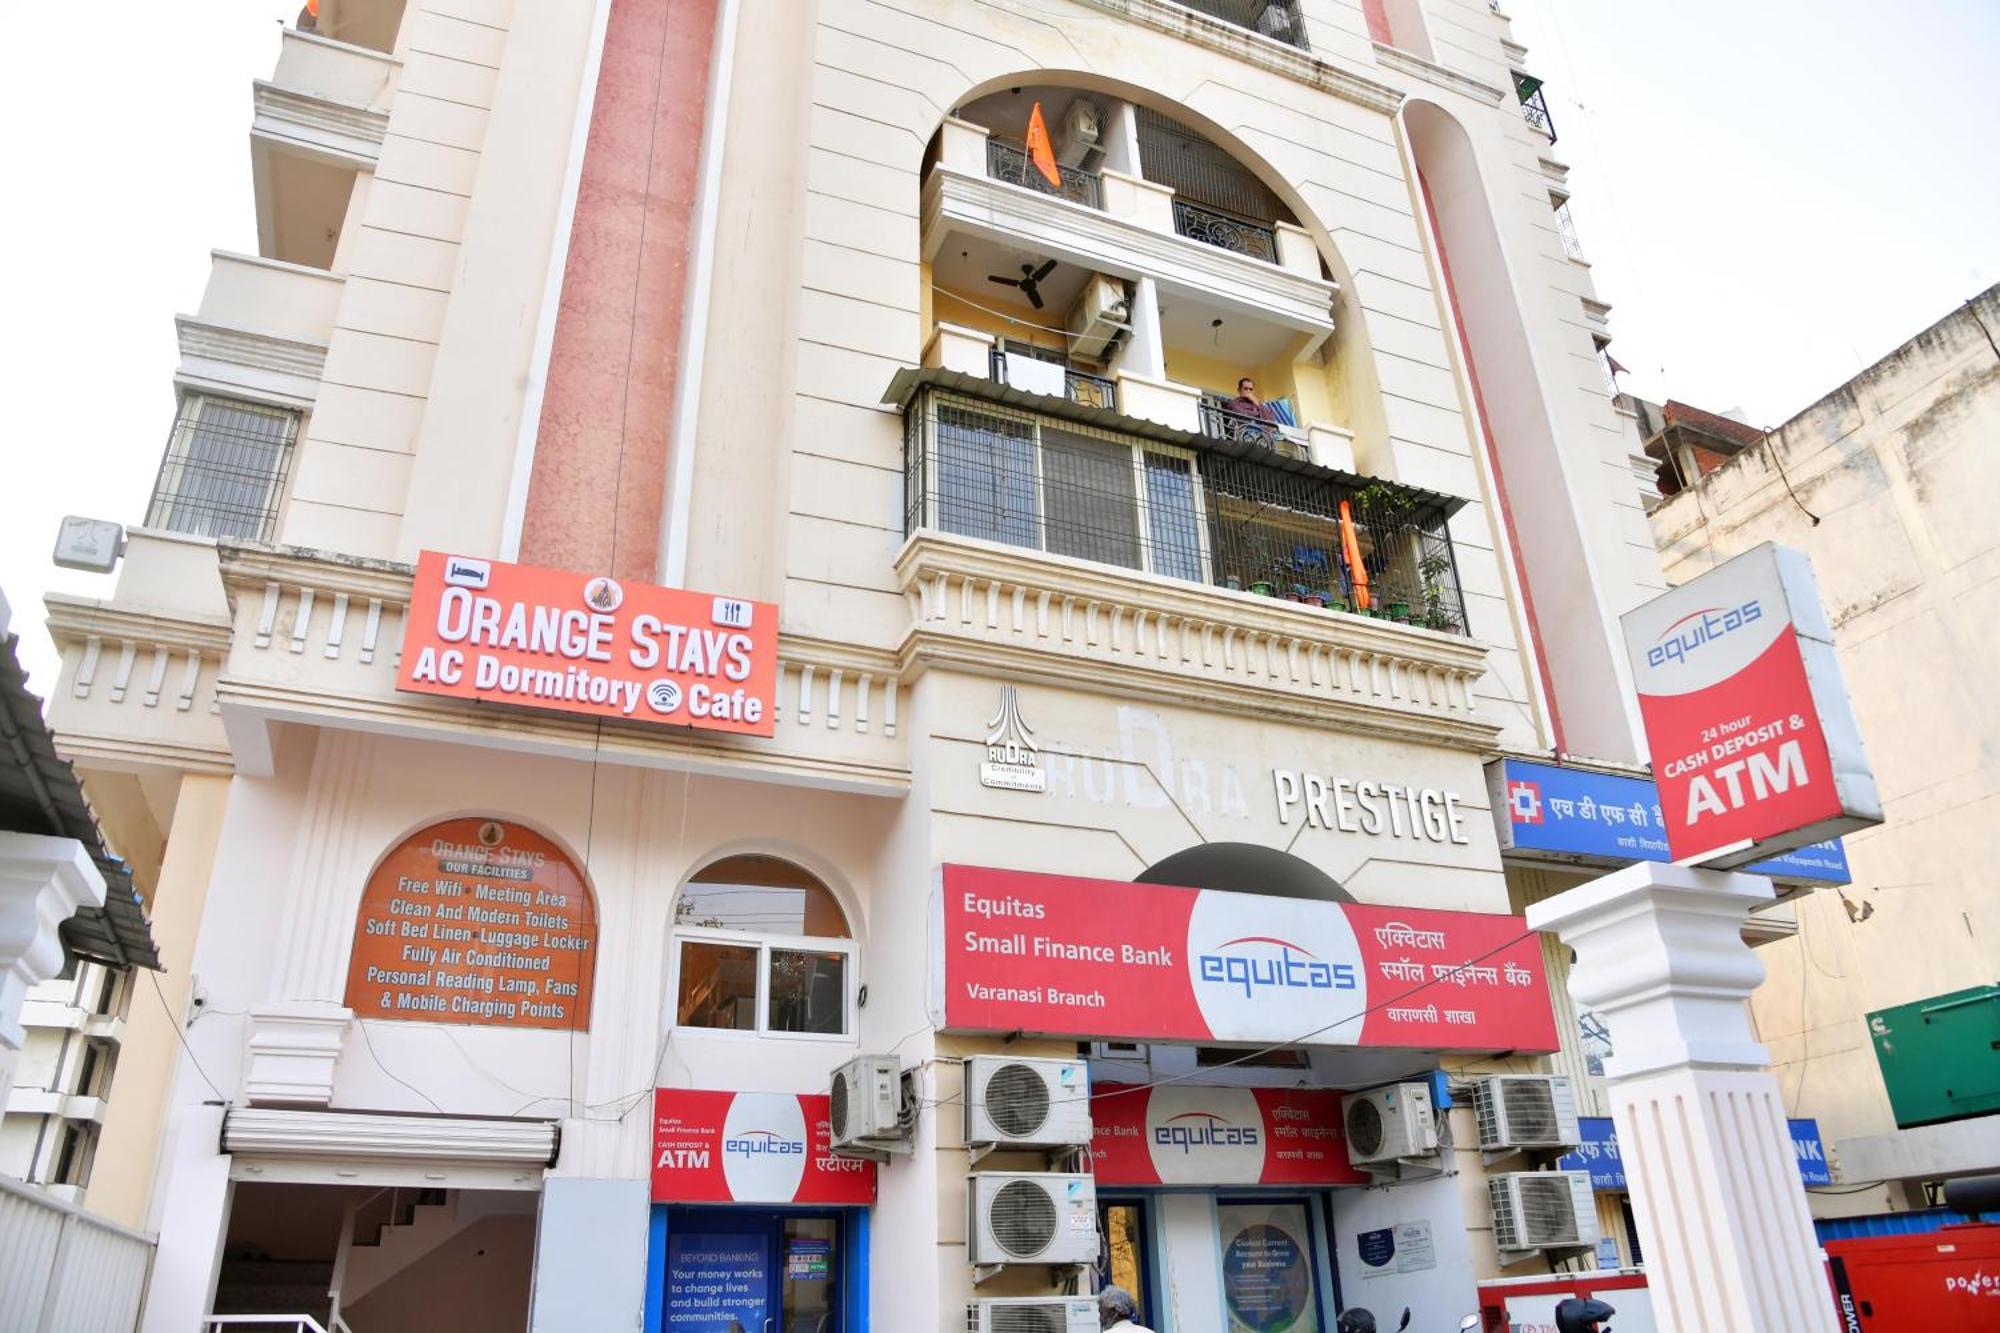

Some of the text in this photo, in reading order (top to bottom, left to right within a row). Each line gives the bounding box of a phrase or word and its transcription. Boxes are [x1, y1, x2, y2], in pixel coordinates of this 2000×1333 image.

[437, 586, 753, 681] ORANGE STAYS
[1647, 600, 1763, 668] equitas
[412, 647, 762, 723] AC Dormitory Cafe
[1701, 713, 1752, 744] 24 hour
[1664, 713, 1805, 779] CASH DEPOSIT &
[1685, 740, 1810, 826] ATM
[1272, 769, 1470, 845] PRESTIGE
[1549, 797, 1574, 820] एच
[1577, 795, 1598, 821] डी
[1599, 804, 1625, 827] एफ
[1627, 802, 1649, 828] सी
[431, 839, 546, 869] ORANGE STAYS
[446, 861, 528, 880] OUR FACILITIES
[398, 877, 567, 907] Free Wifi Meeting Area
[963, 893, 1046, 920] Equitas
[390, 899, 569, 930] Clean And Modern Toilets
[366, 919, 589, 950] Soft Bed Linen Luggage Locker
[964, 931, 1174, 968] Small Finance Bank
[1374, 921, 1446, 951] एक्विटास
[402, 944, 550, 971] Fully Air Conditioned
[1379, 956, 1425, 984] स्मॉल
[1503, 961, 1532, 988] बैंक
[367, 966, 578, 997] Personal Reading Lamp, Fans
[1199, 947, 1357, 1000] equitas
[380, 991, 565, 1019] & Mobile Charging Points
[966, 982, 1107, 1009] Varanasi Branch
[1386, 1004, 1477, 1026] वाराणसी शाखा
[658, 1141, 676, 1149] CASH
[676, 1141, 704, 1150] DEPOSIT
[1113, 1125, 1140, 1137] Bank
[1155, 1118, 1258, 1155] equitas
[657, 1150, 710, 1169] ATM
[725, 1136, 804, 1159] equitas
[1792, 1139, 1823, 1161] NK
[815, 1154, 865, 1173] एटीएम
[1591, 1172, 1613, 1186] काशी
[680, 1251, 760, 1264] BEYOND BANKING
[671, 1282, 749, 1296] to change lives
[672, 1268, 763, 1281] Your money works
[670, 1297, 765, 1309] and build stronger
[670, 1311, 738, 1323] communities.
[1841, 1294, 1860, 1333] OWER
